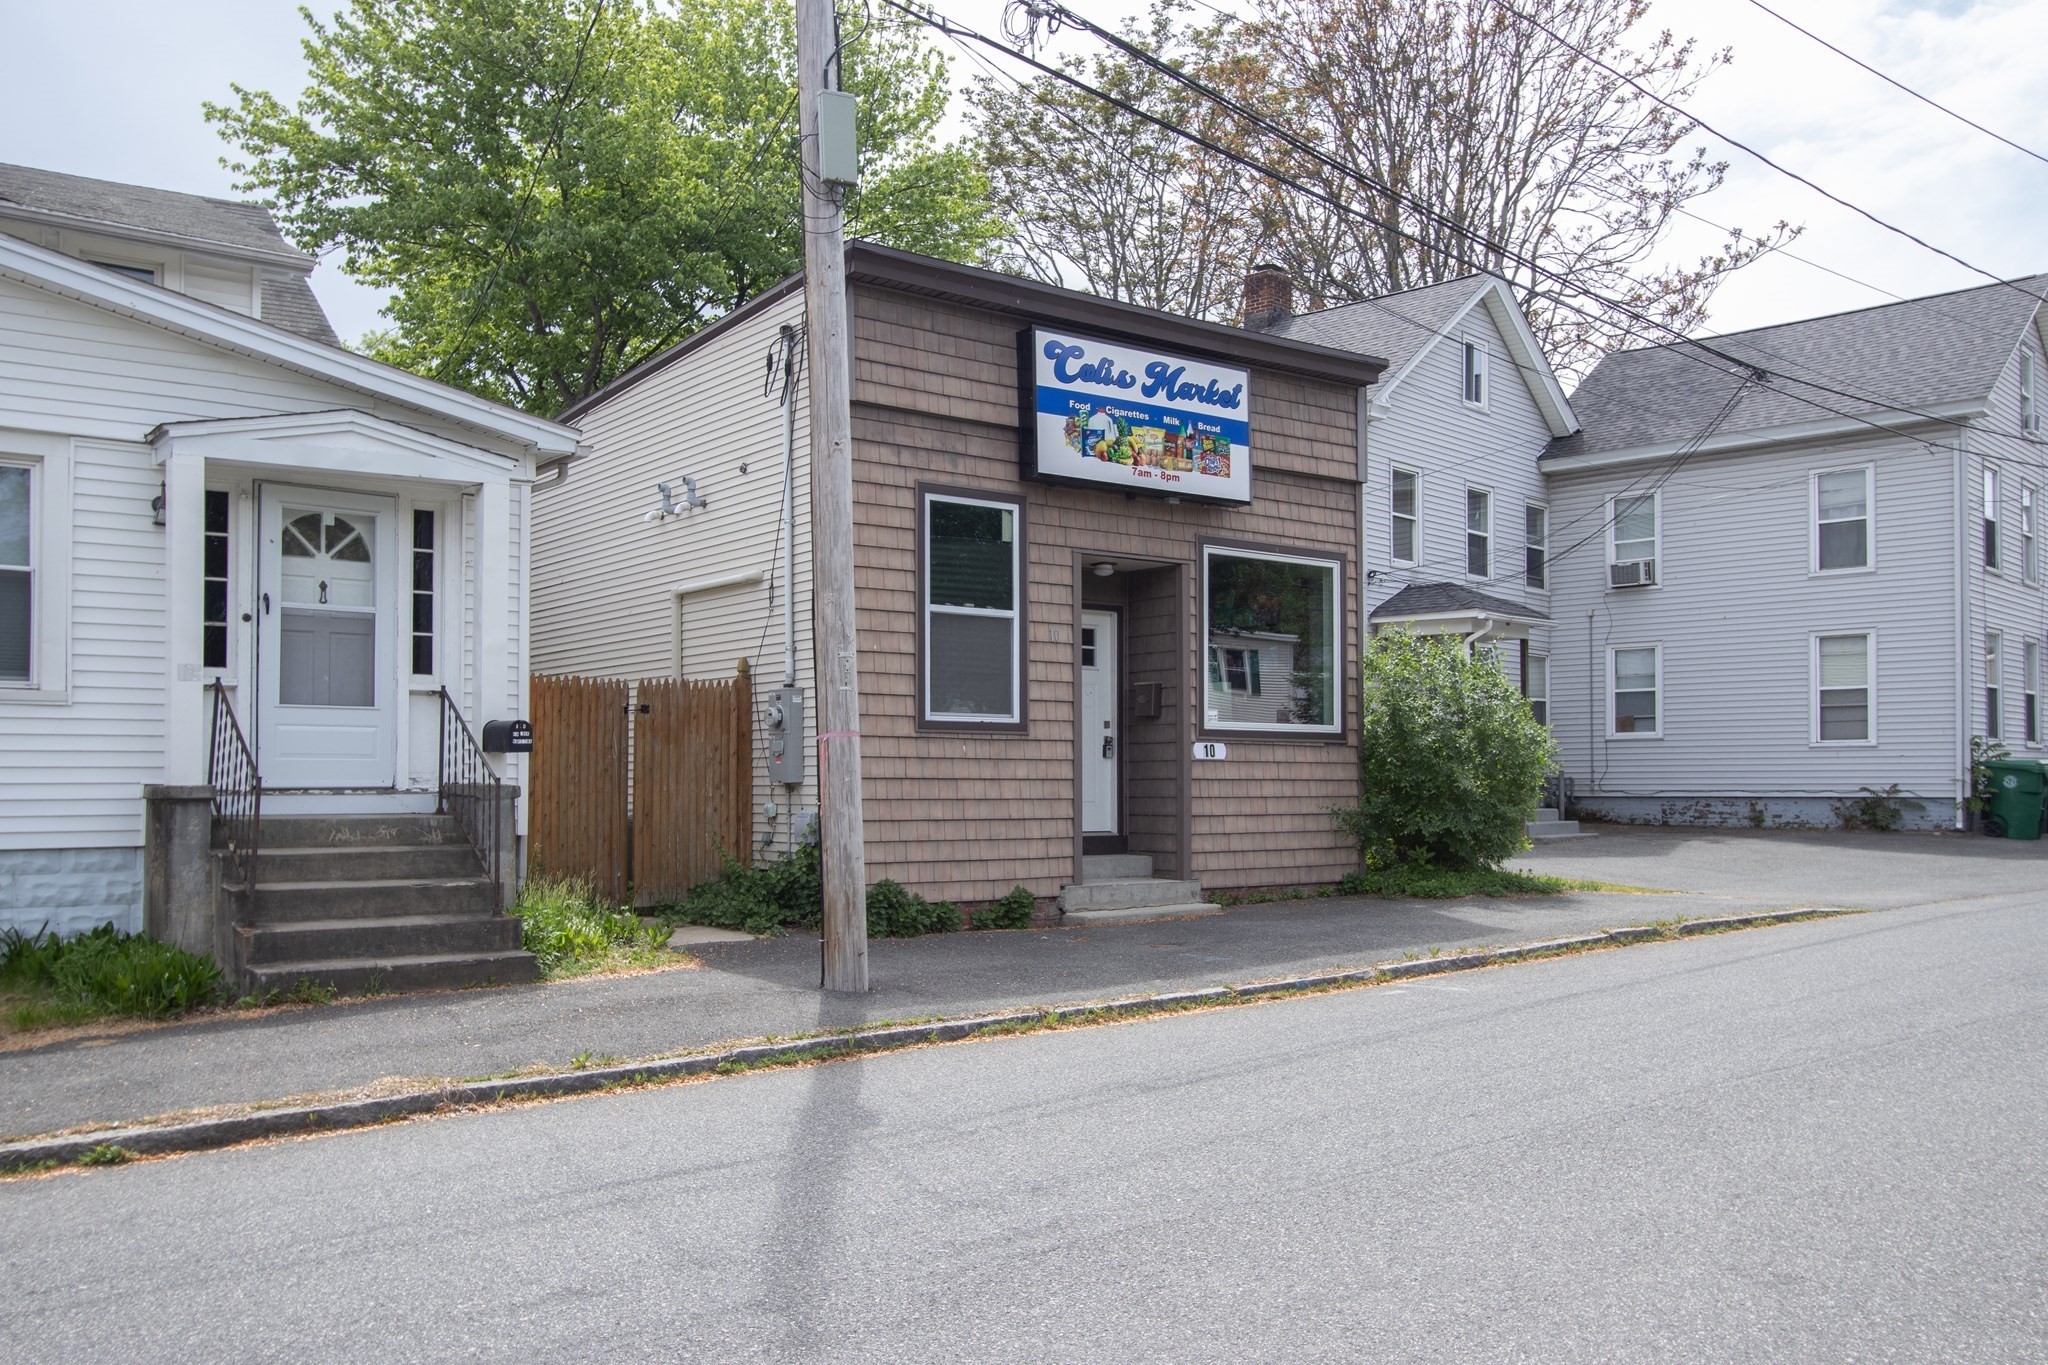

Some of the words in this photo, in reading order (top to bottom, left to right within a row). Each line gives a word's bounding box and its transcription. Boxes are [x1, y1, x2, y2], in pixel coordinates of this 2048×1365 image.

[1141, 361, 1242, 409] Market
[1069, 400, 1091, 411] Food
[1105, 405, 1150, 421] Cigarettes
[1163, 415, 1180, 426] Milk
[1197, 422, 1221, 433] Bread
[1132, 466, 1152, 478] 7am
[1160, 470, 1180, 482] 8pm
[1203, 743, 1216, 758] 10
